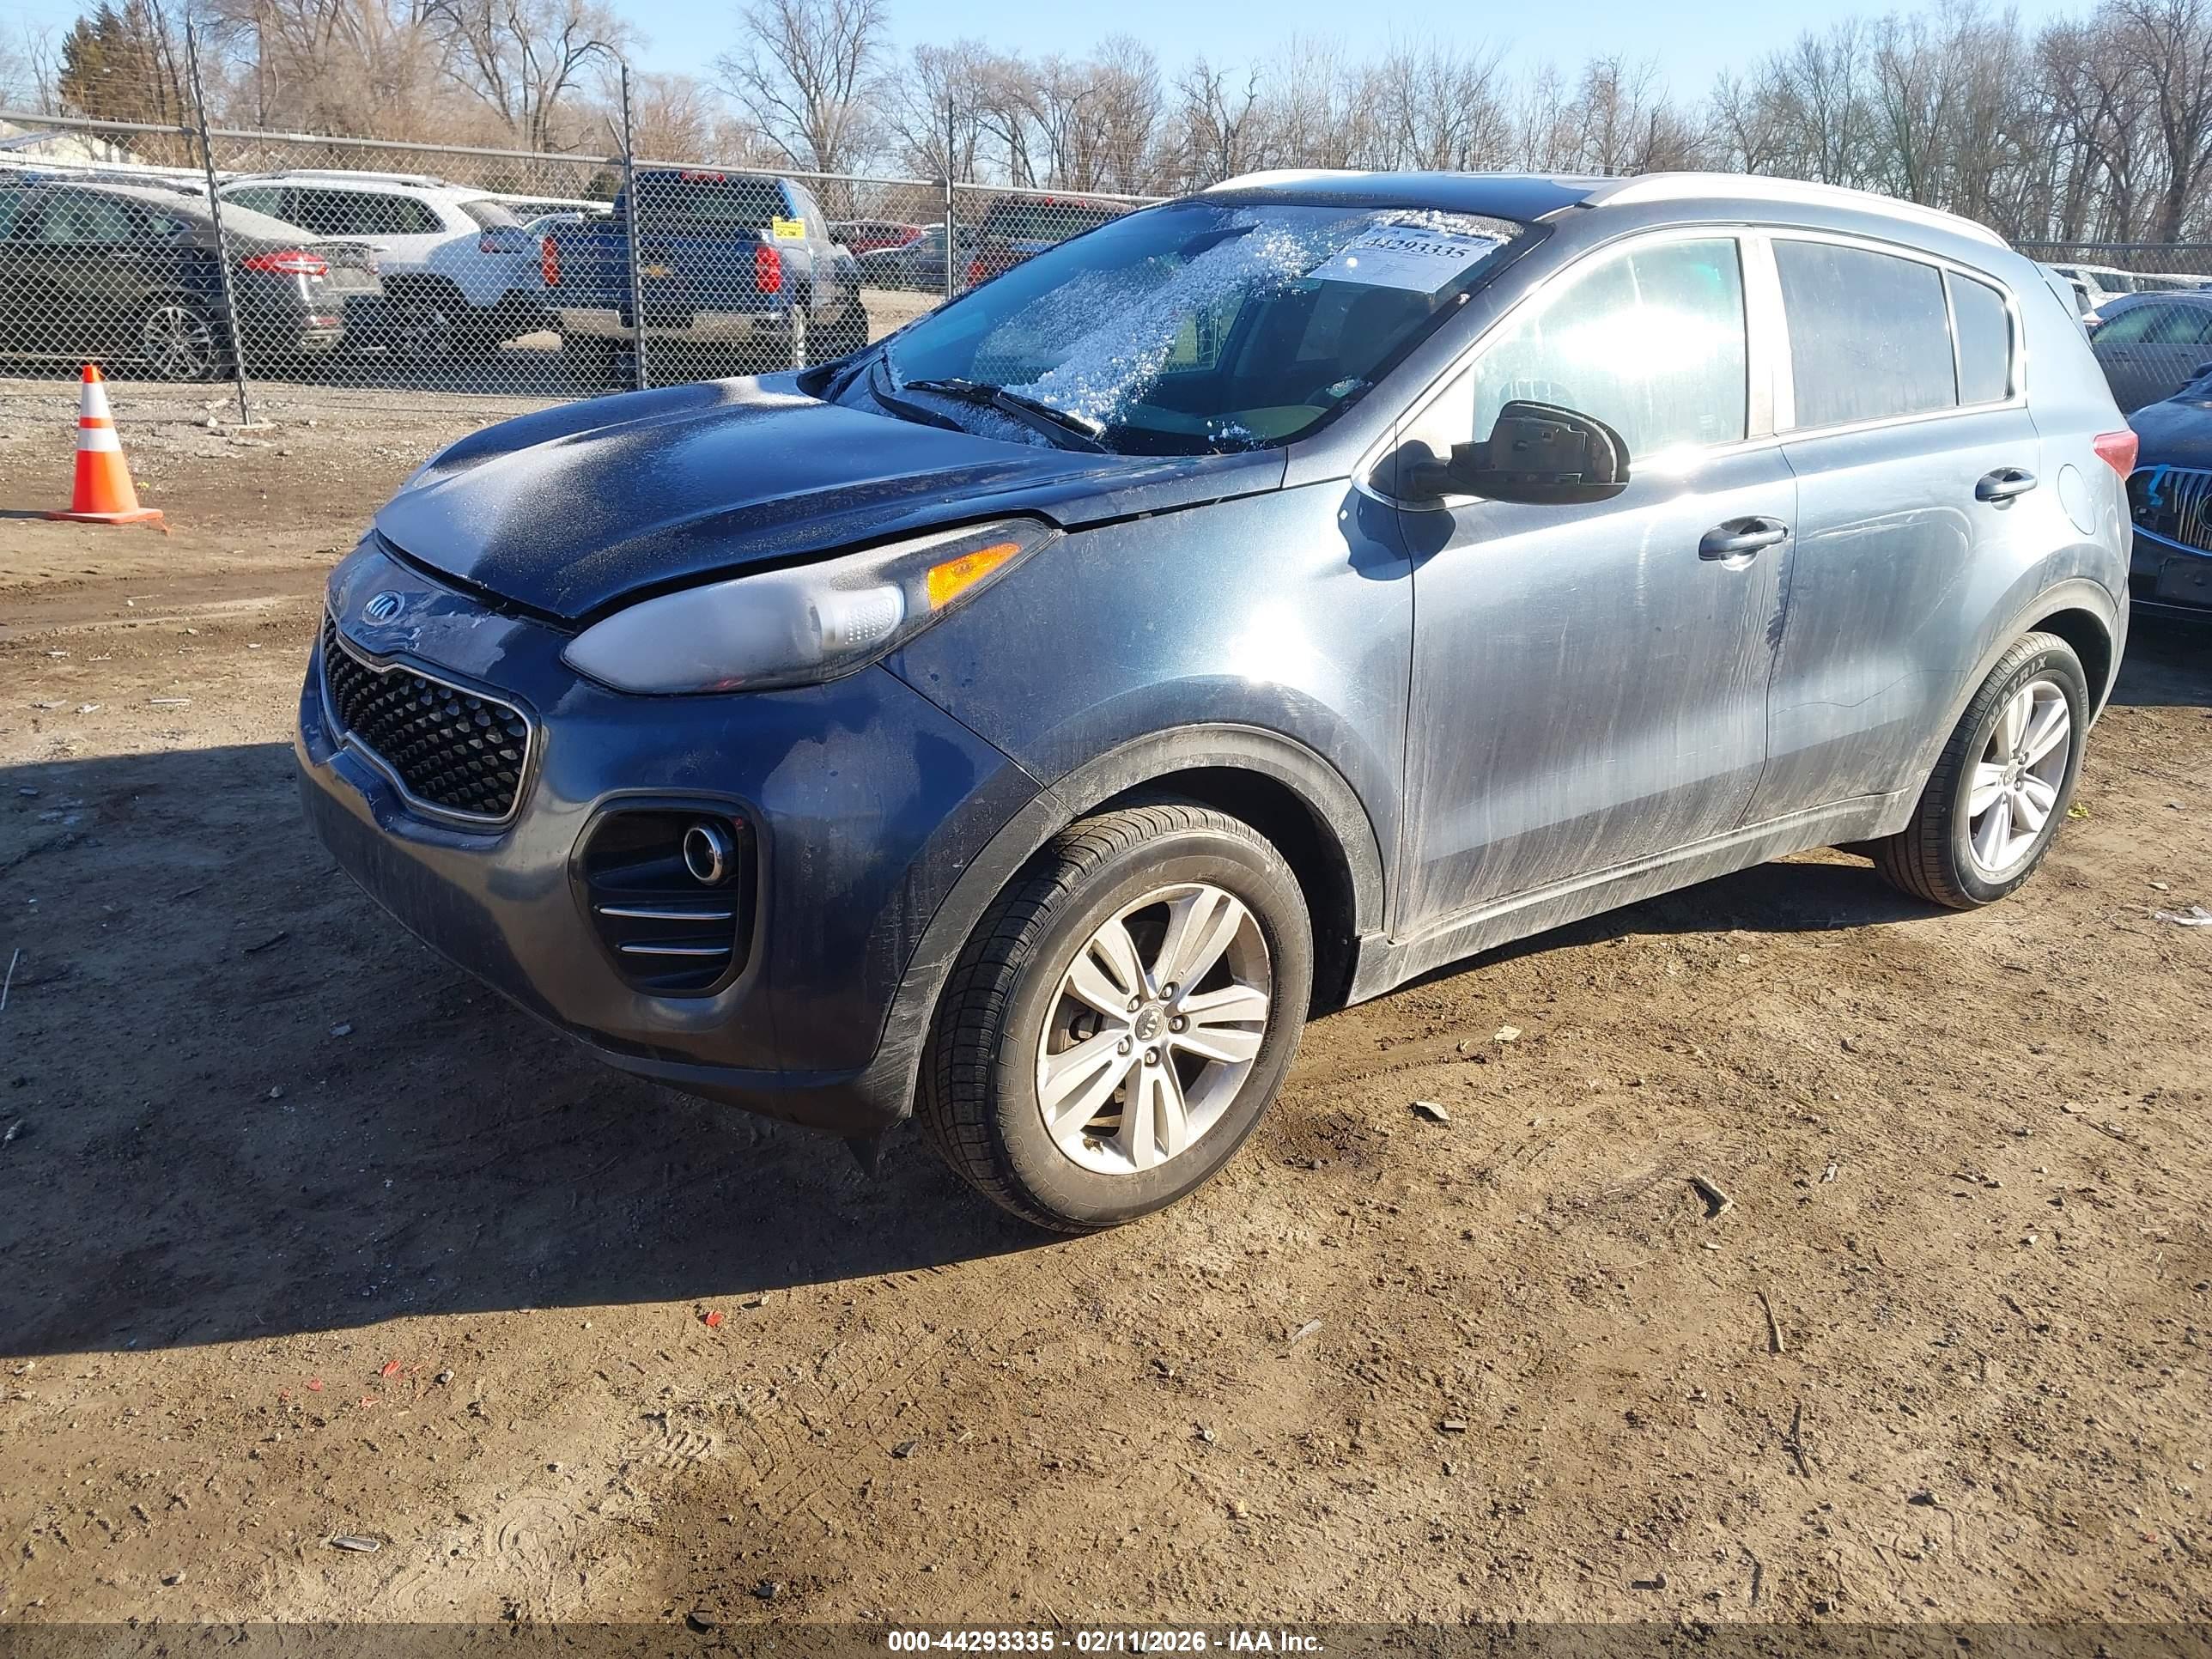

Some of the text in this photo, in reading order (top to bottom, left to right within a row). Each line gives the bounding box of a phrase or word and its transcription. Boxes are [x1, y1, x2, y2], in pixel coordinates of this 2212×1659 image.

[1365, 238, 1470, 258] 44293335
[1986, 655, 2048, 729] MATRIX
[1140, 1010, 1161, 1040] KIA
